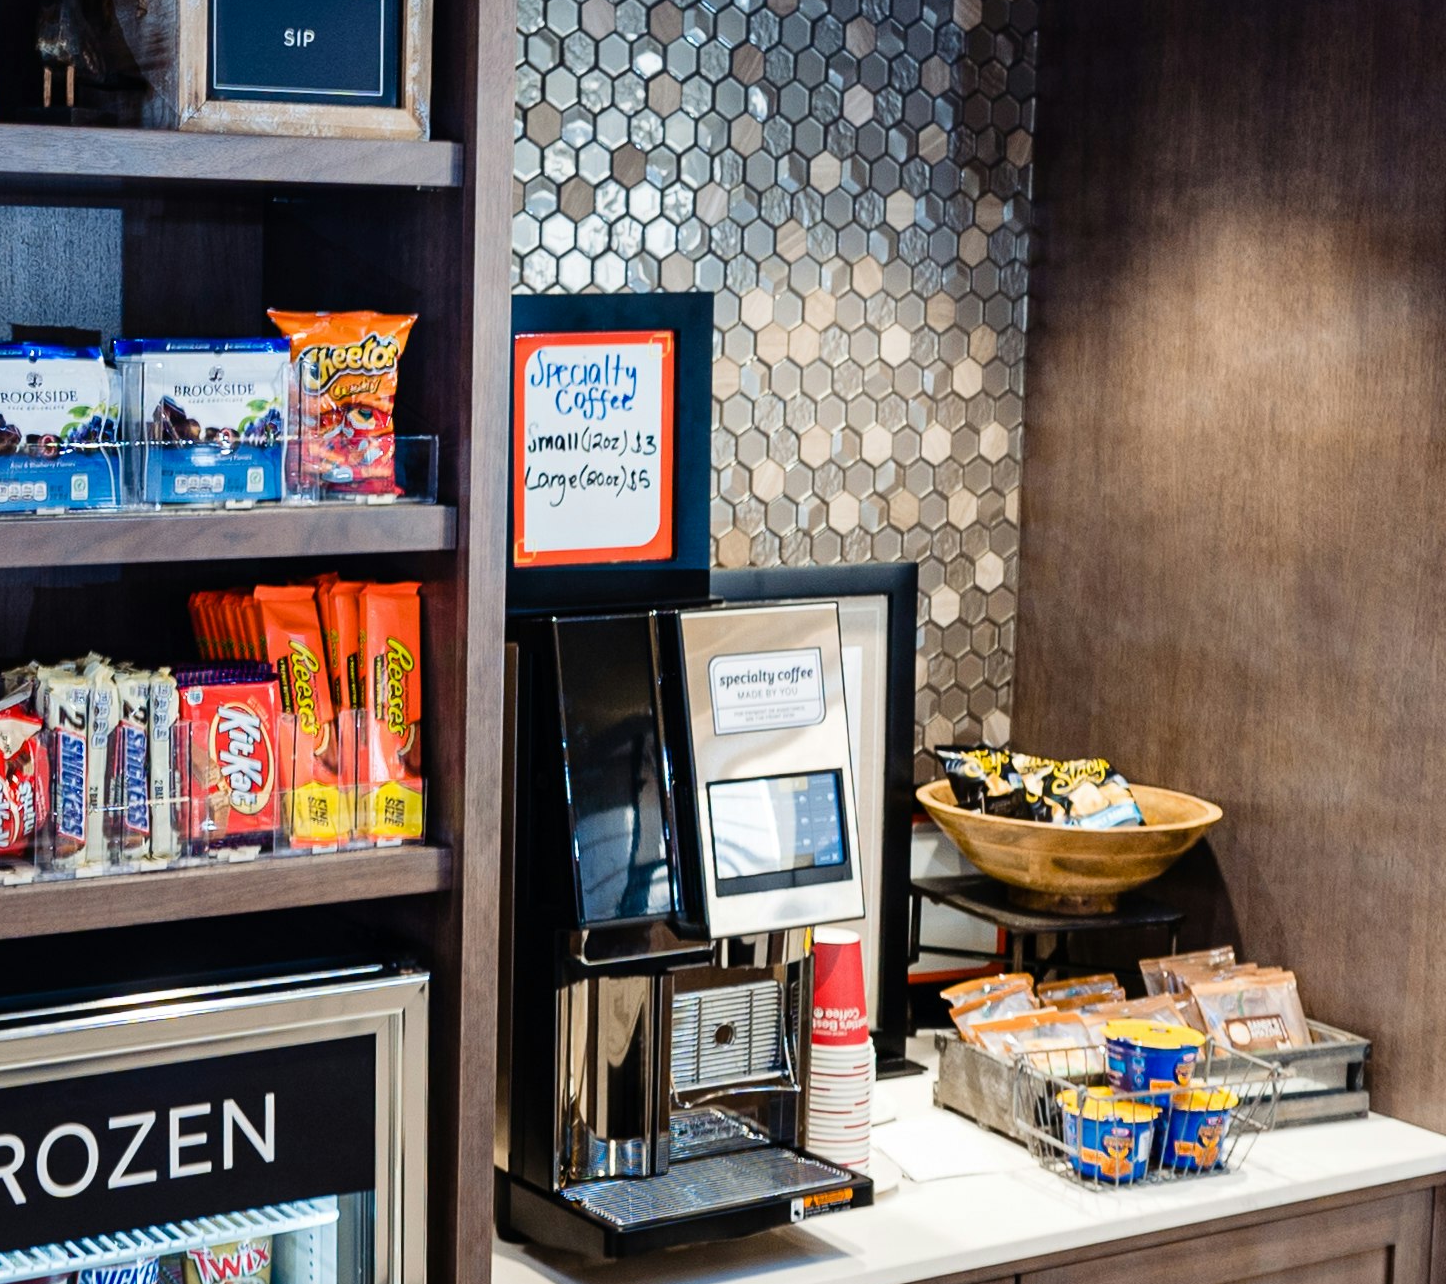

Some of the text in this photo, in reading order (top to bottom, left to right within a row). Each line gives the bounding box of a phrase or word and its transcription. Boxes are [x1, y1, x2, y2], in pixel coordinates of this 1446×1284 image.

[282, 27, 316, 48] SIP
[306, 331, 399, 393] Cheetos
[530, 349, 637, 399] Specialty
[173, 383, 256, 397] BROOKSIDE
[555, 386, 634, 421] Coffee
[631, 430, 657, 456] $3
[288, 639, 321, 737] Reese's
[386, 637, 415, 737] Reese's
[719, 666, 813, 689] specialty coffee
[737, 686, 799, 700] MADE BY YOU
[60, 733, 86, 839] SNICKERS
[125, 726, 148, 832] SNICKERS
[18, 781, 34, 837] minis
[307, 796, 318, 824] SIZE
[317, 798, 329, 828] KING
[384, 796, 395, 825] SIZE
[394, 798, 405, 828] KING
